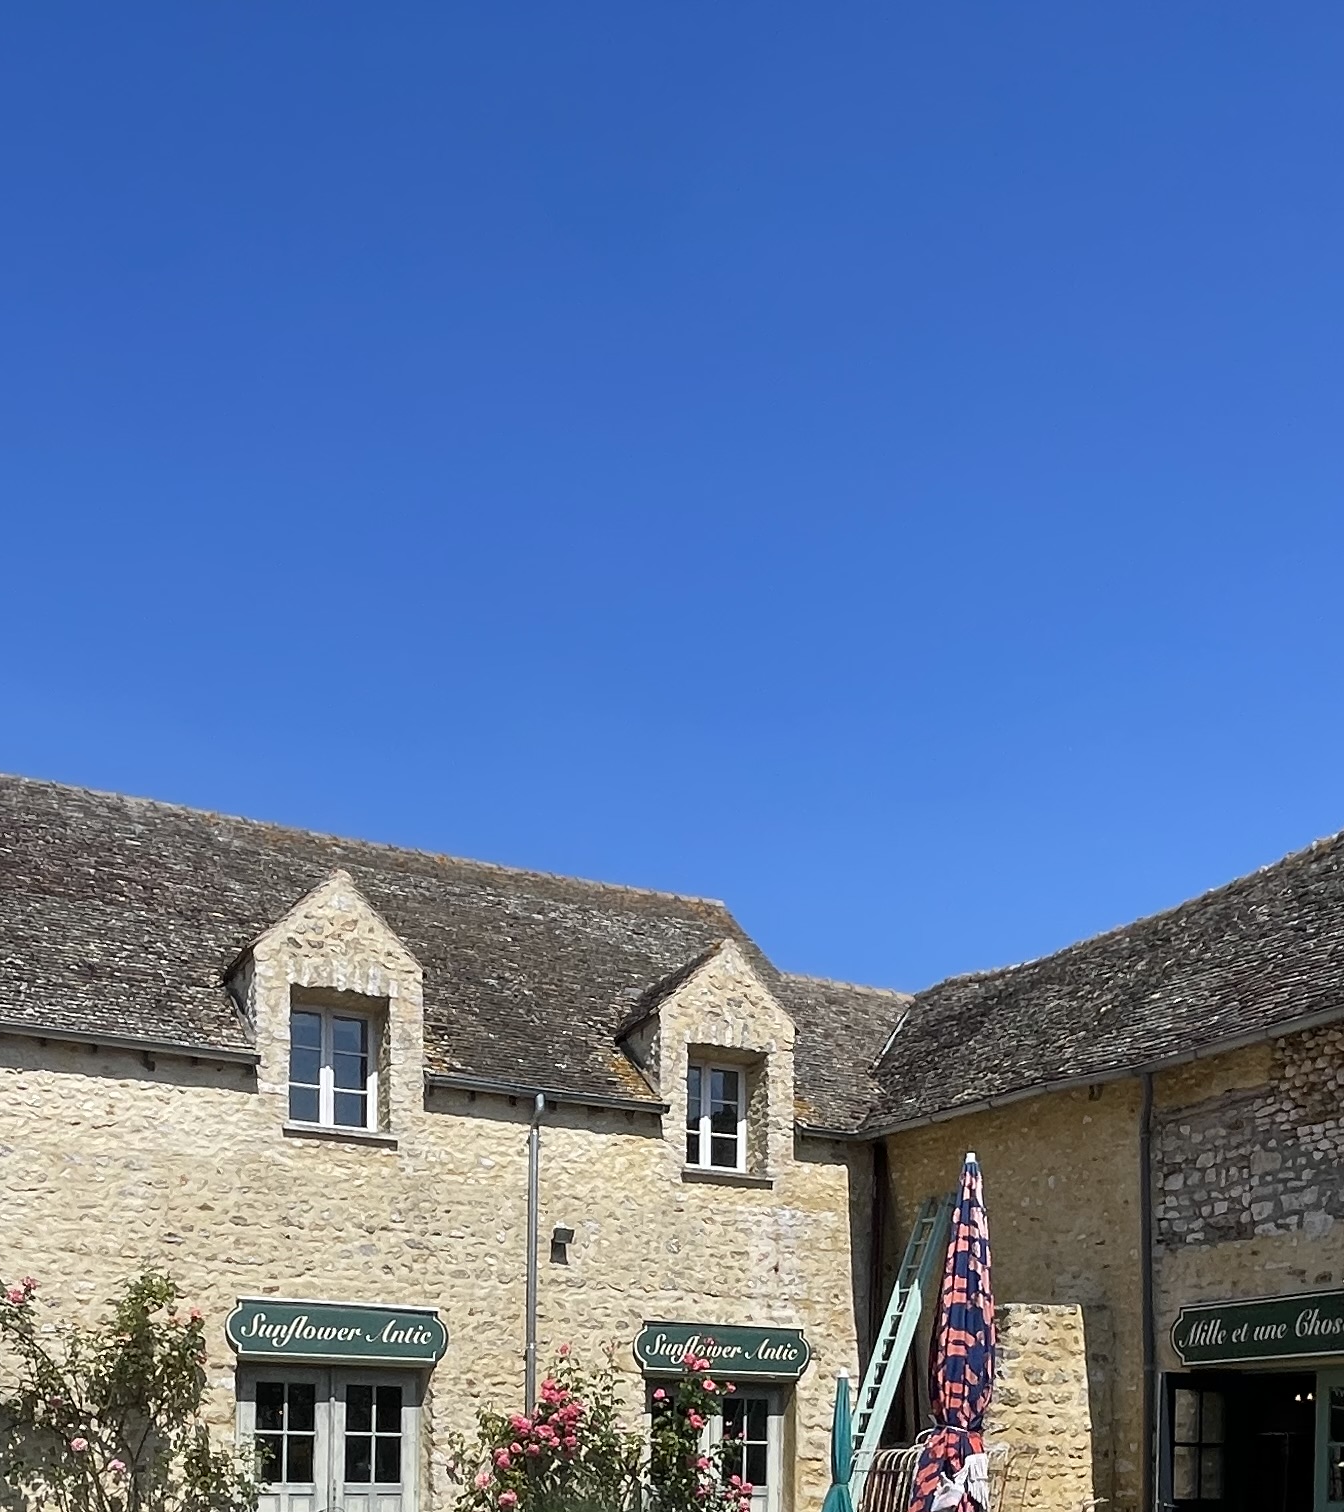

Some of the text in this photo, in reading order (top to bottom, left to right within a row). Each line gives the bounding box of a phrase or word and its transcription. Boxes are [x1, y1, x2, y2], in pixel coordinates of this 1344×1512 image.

[240, 1313, 433, 1347] Sunflower Antic
[1179, 1319, 1227, 1348] Mille
[1231, 1322, 1249, 1343] et
[1253, 1323, 1287, 1341] une
[645, 1333, 799, 1364] Sunflower Antic
